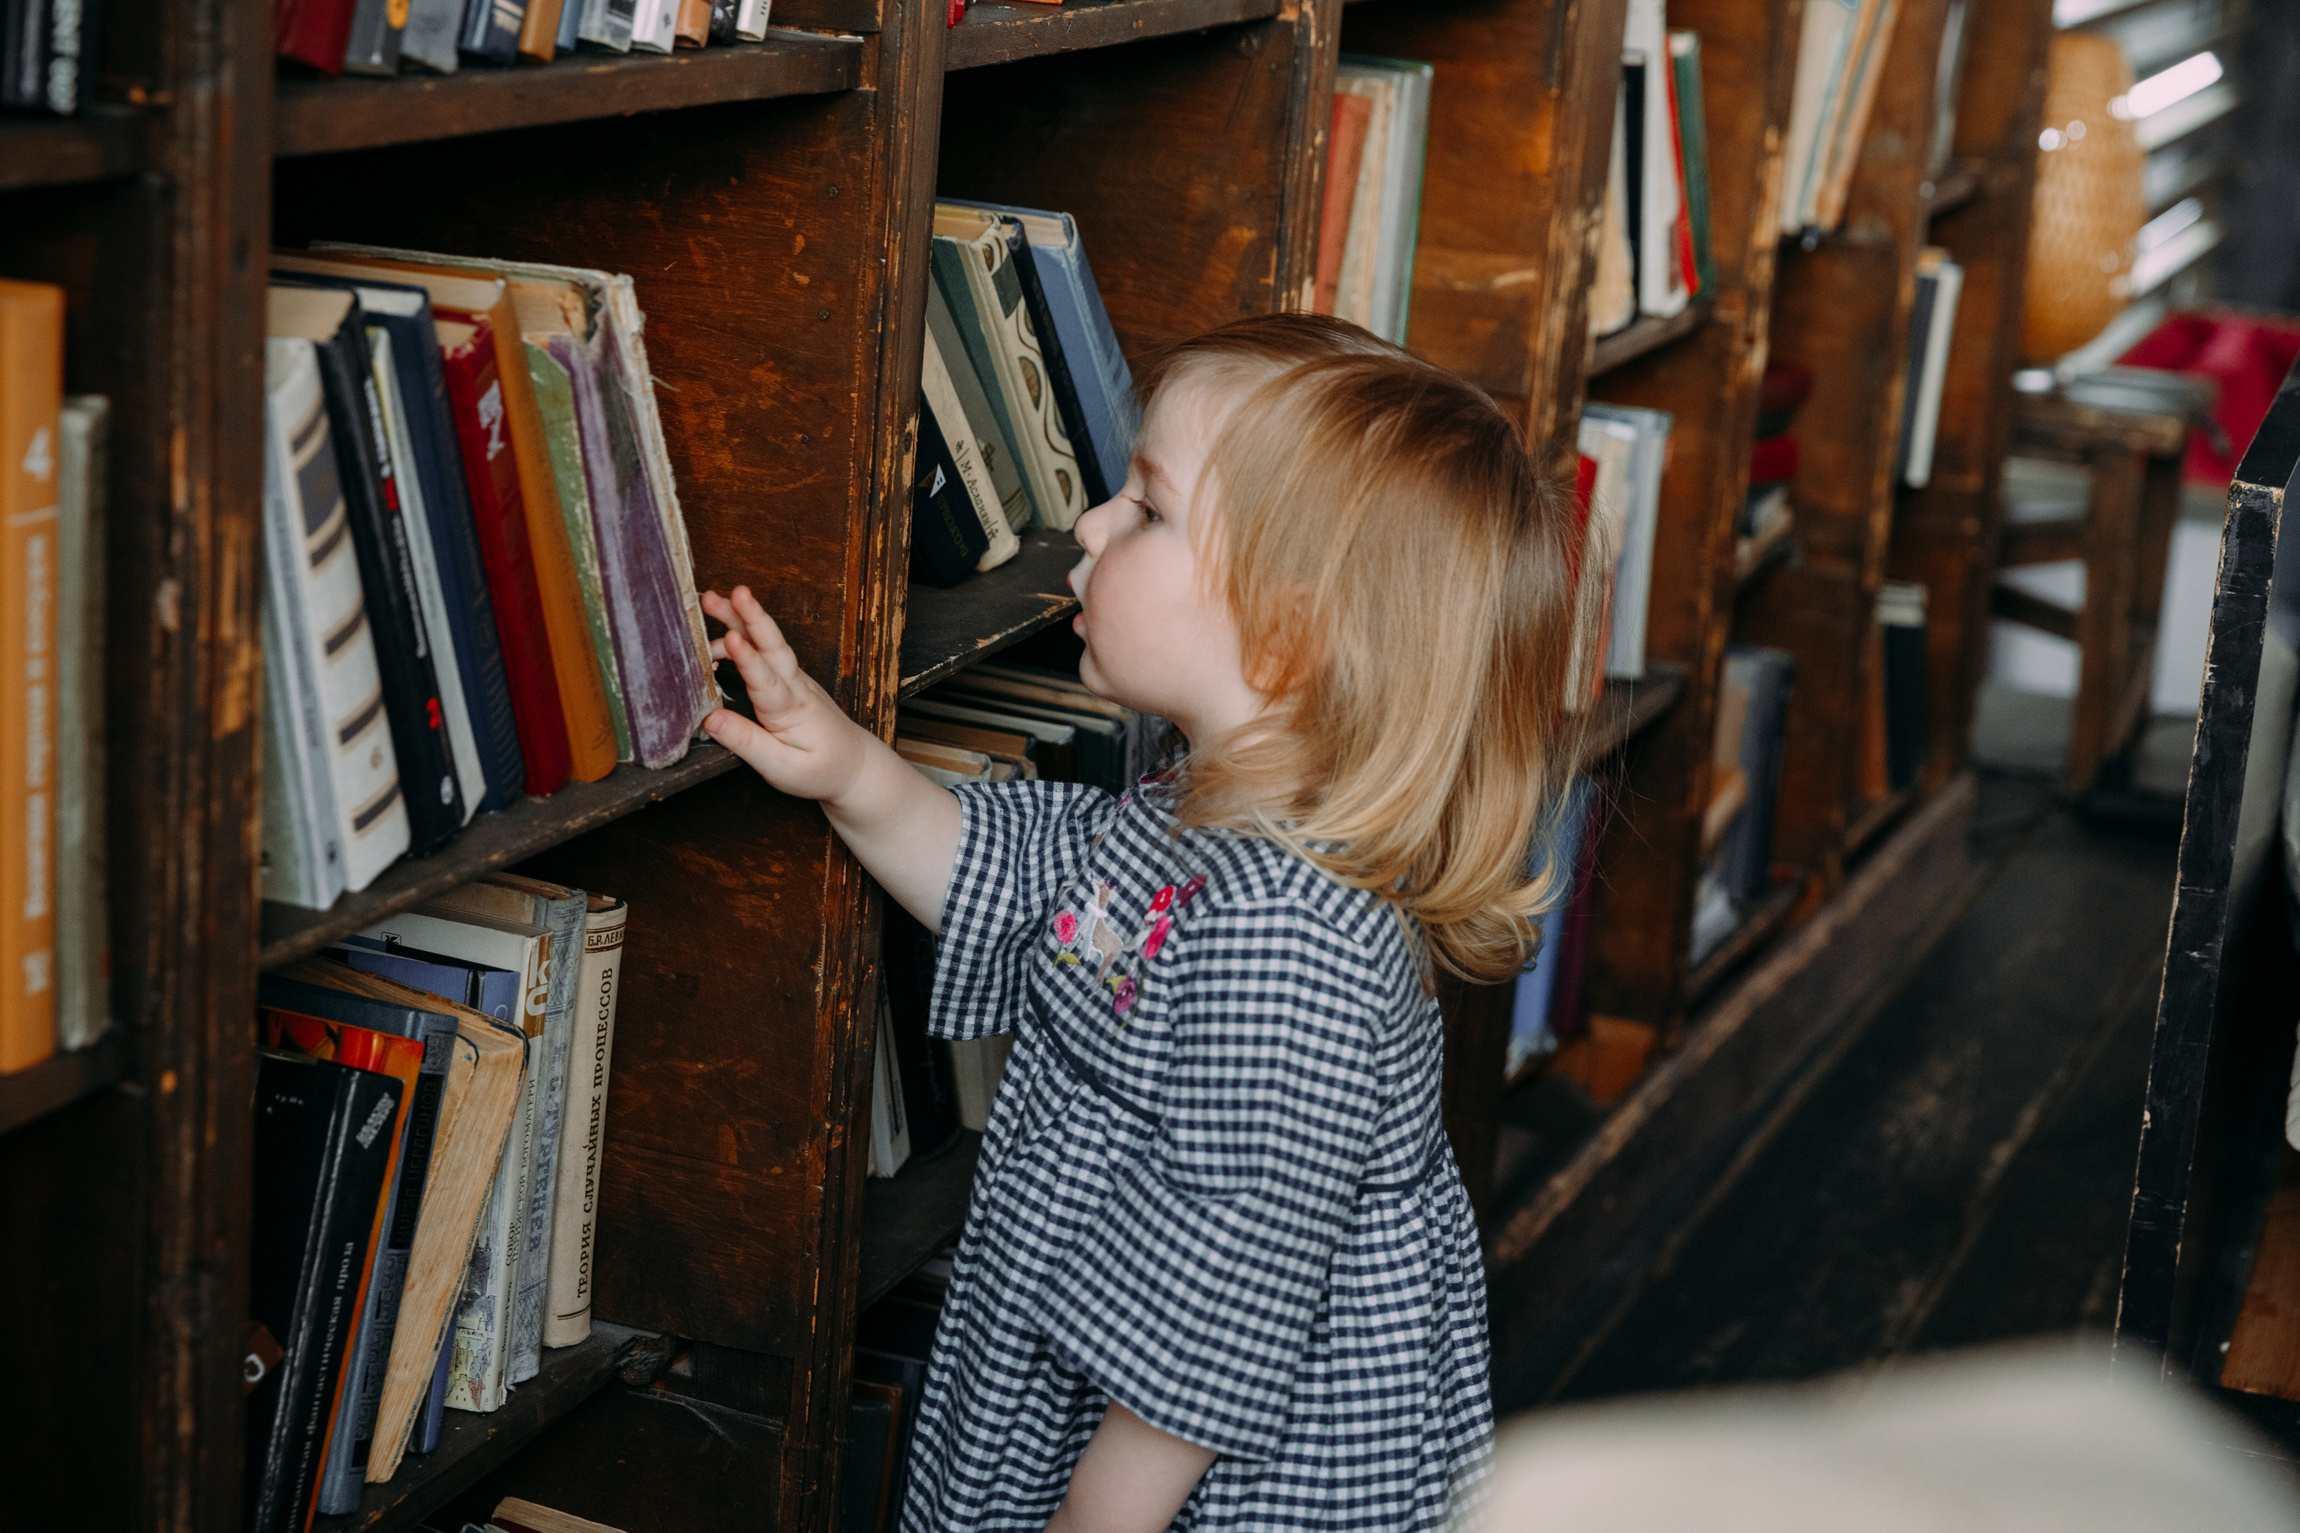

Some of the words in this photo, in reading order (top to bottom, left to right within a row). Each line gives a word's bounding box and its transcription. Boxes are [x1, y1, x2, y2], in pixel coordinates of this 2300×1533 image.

[587, 930, 625, 947] Б.Р.ЛЕВИ
[593, 967, 613, 1090] ПРОЦЕССОВ
[513, 1174, 527, 1263] ПАРИЖСКОЙ
[521, 1078, 536, 1169] БОГОМАТЕРИ
[528, 1102, 560, 1253] ТУРГЕНЕВ
[582, 1095, 602, 1214] СЛУЧАЙНЫХ
[505, 1222, 515, 1267] СОБОР
[577, 1220, 592, 1299] ТЕОРИЯ
[306, 1296, 343, 1435] фантастическая
[336, 1241, 354, 1290] проза
